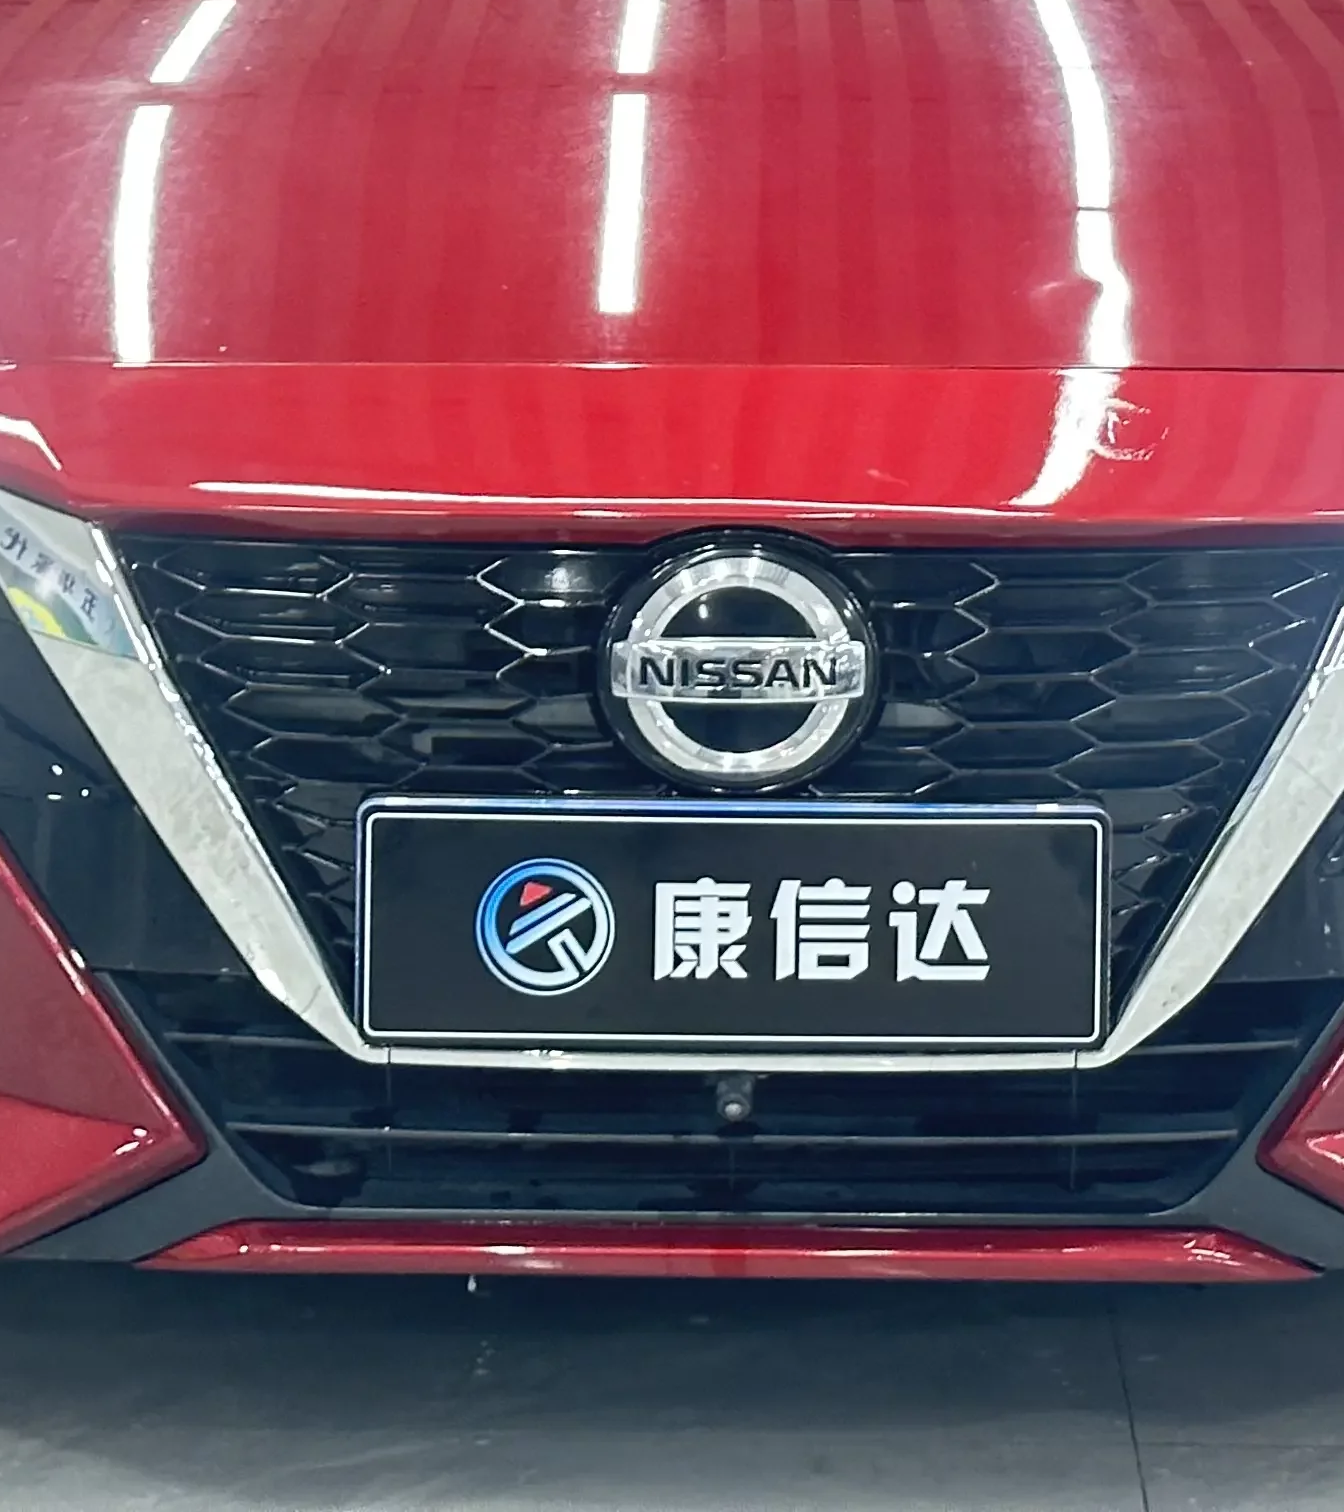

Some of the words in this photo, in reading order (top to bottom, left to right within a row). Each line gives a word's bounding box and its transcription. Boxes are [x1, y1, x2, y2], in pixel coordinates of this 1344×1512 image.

[638, 655, 839, 689] NISSAN
[652, 876, 992, 982] 康信达
